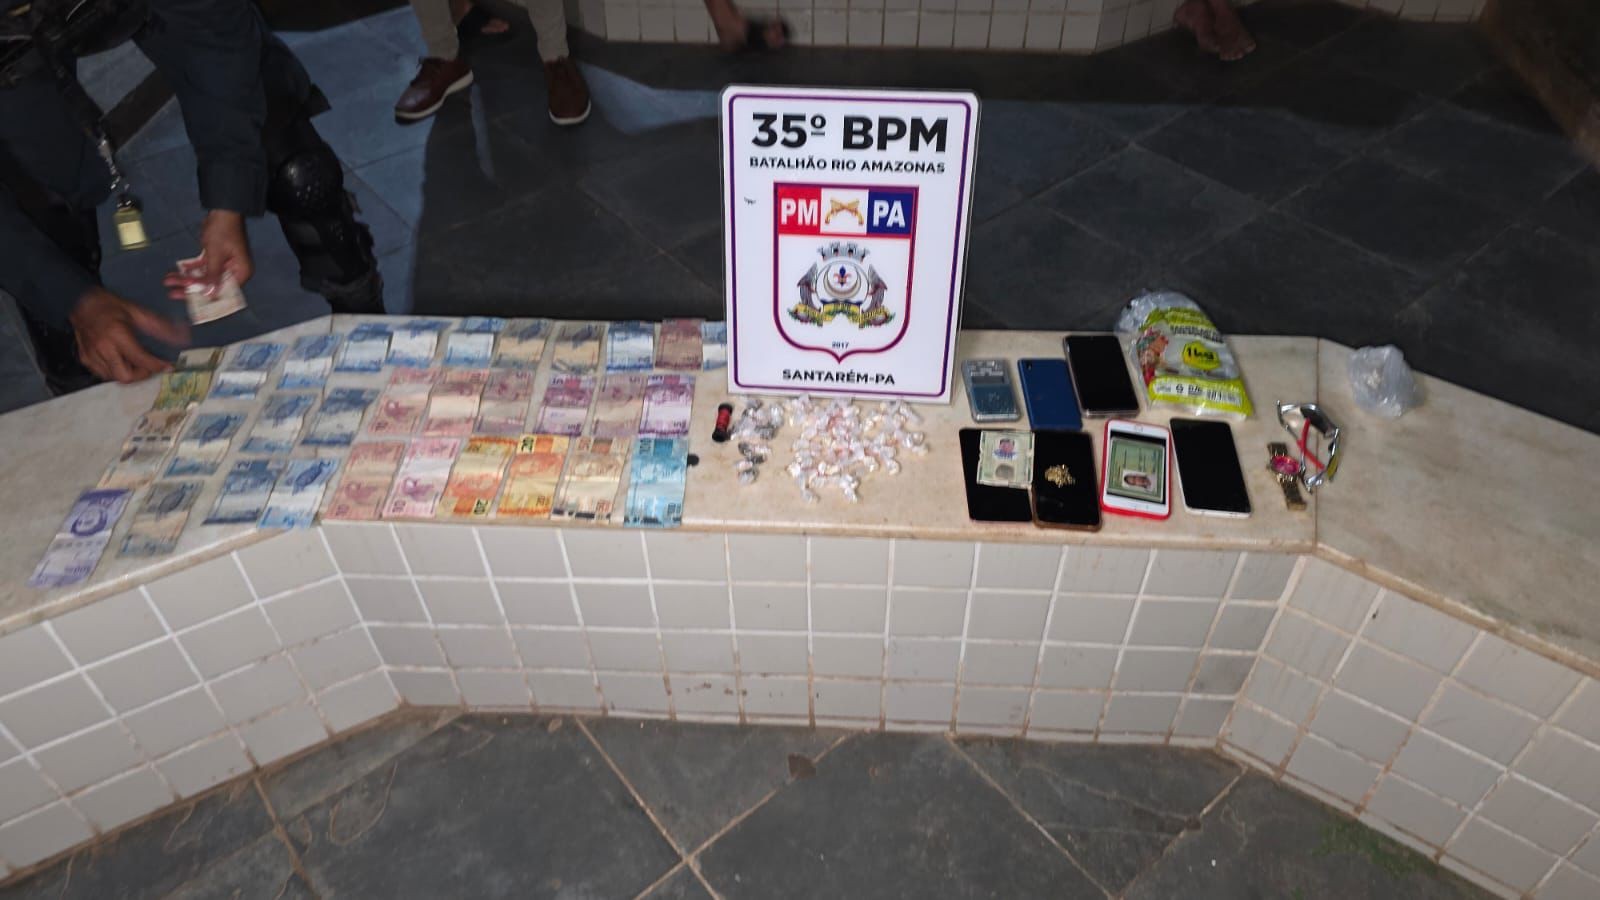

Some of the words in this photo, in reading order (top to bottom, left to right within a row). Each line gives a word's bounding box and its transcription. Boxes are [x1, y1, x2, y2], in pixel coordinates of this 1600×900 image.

[751, 112, 827, 148] 35º
[842, 115, 949, 153] BPM
[749, 155, 827, 170] BATALHÃO
[831, 159, 857, 171] RIO
[860, 160, 946, 173] AMAZONAS
[780, 198, 819, 226] PM
[872, 199, 906, 228] PA
[831, 341, 850, 349] 2017
[782, 367, 896, 386] SANTARÉM-PA
